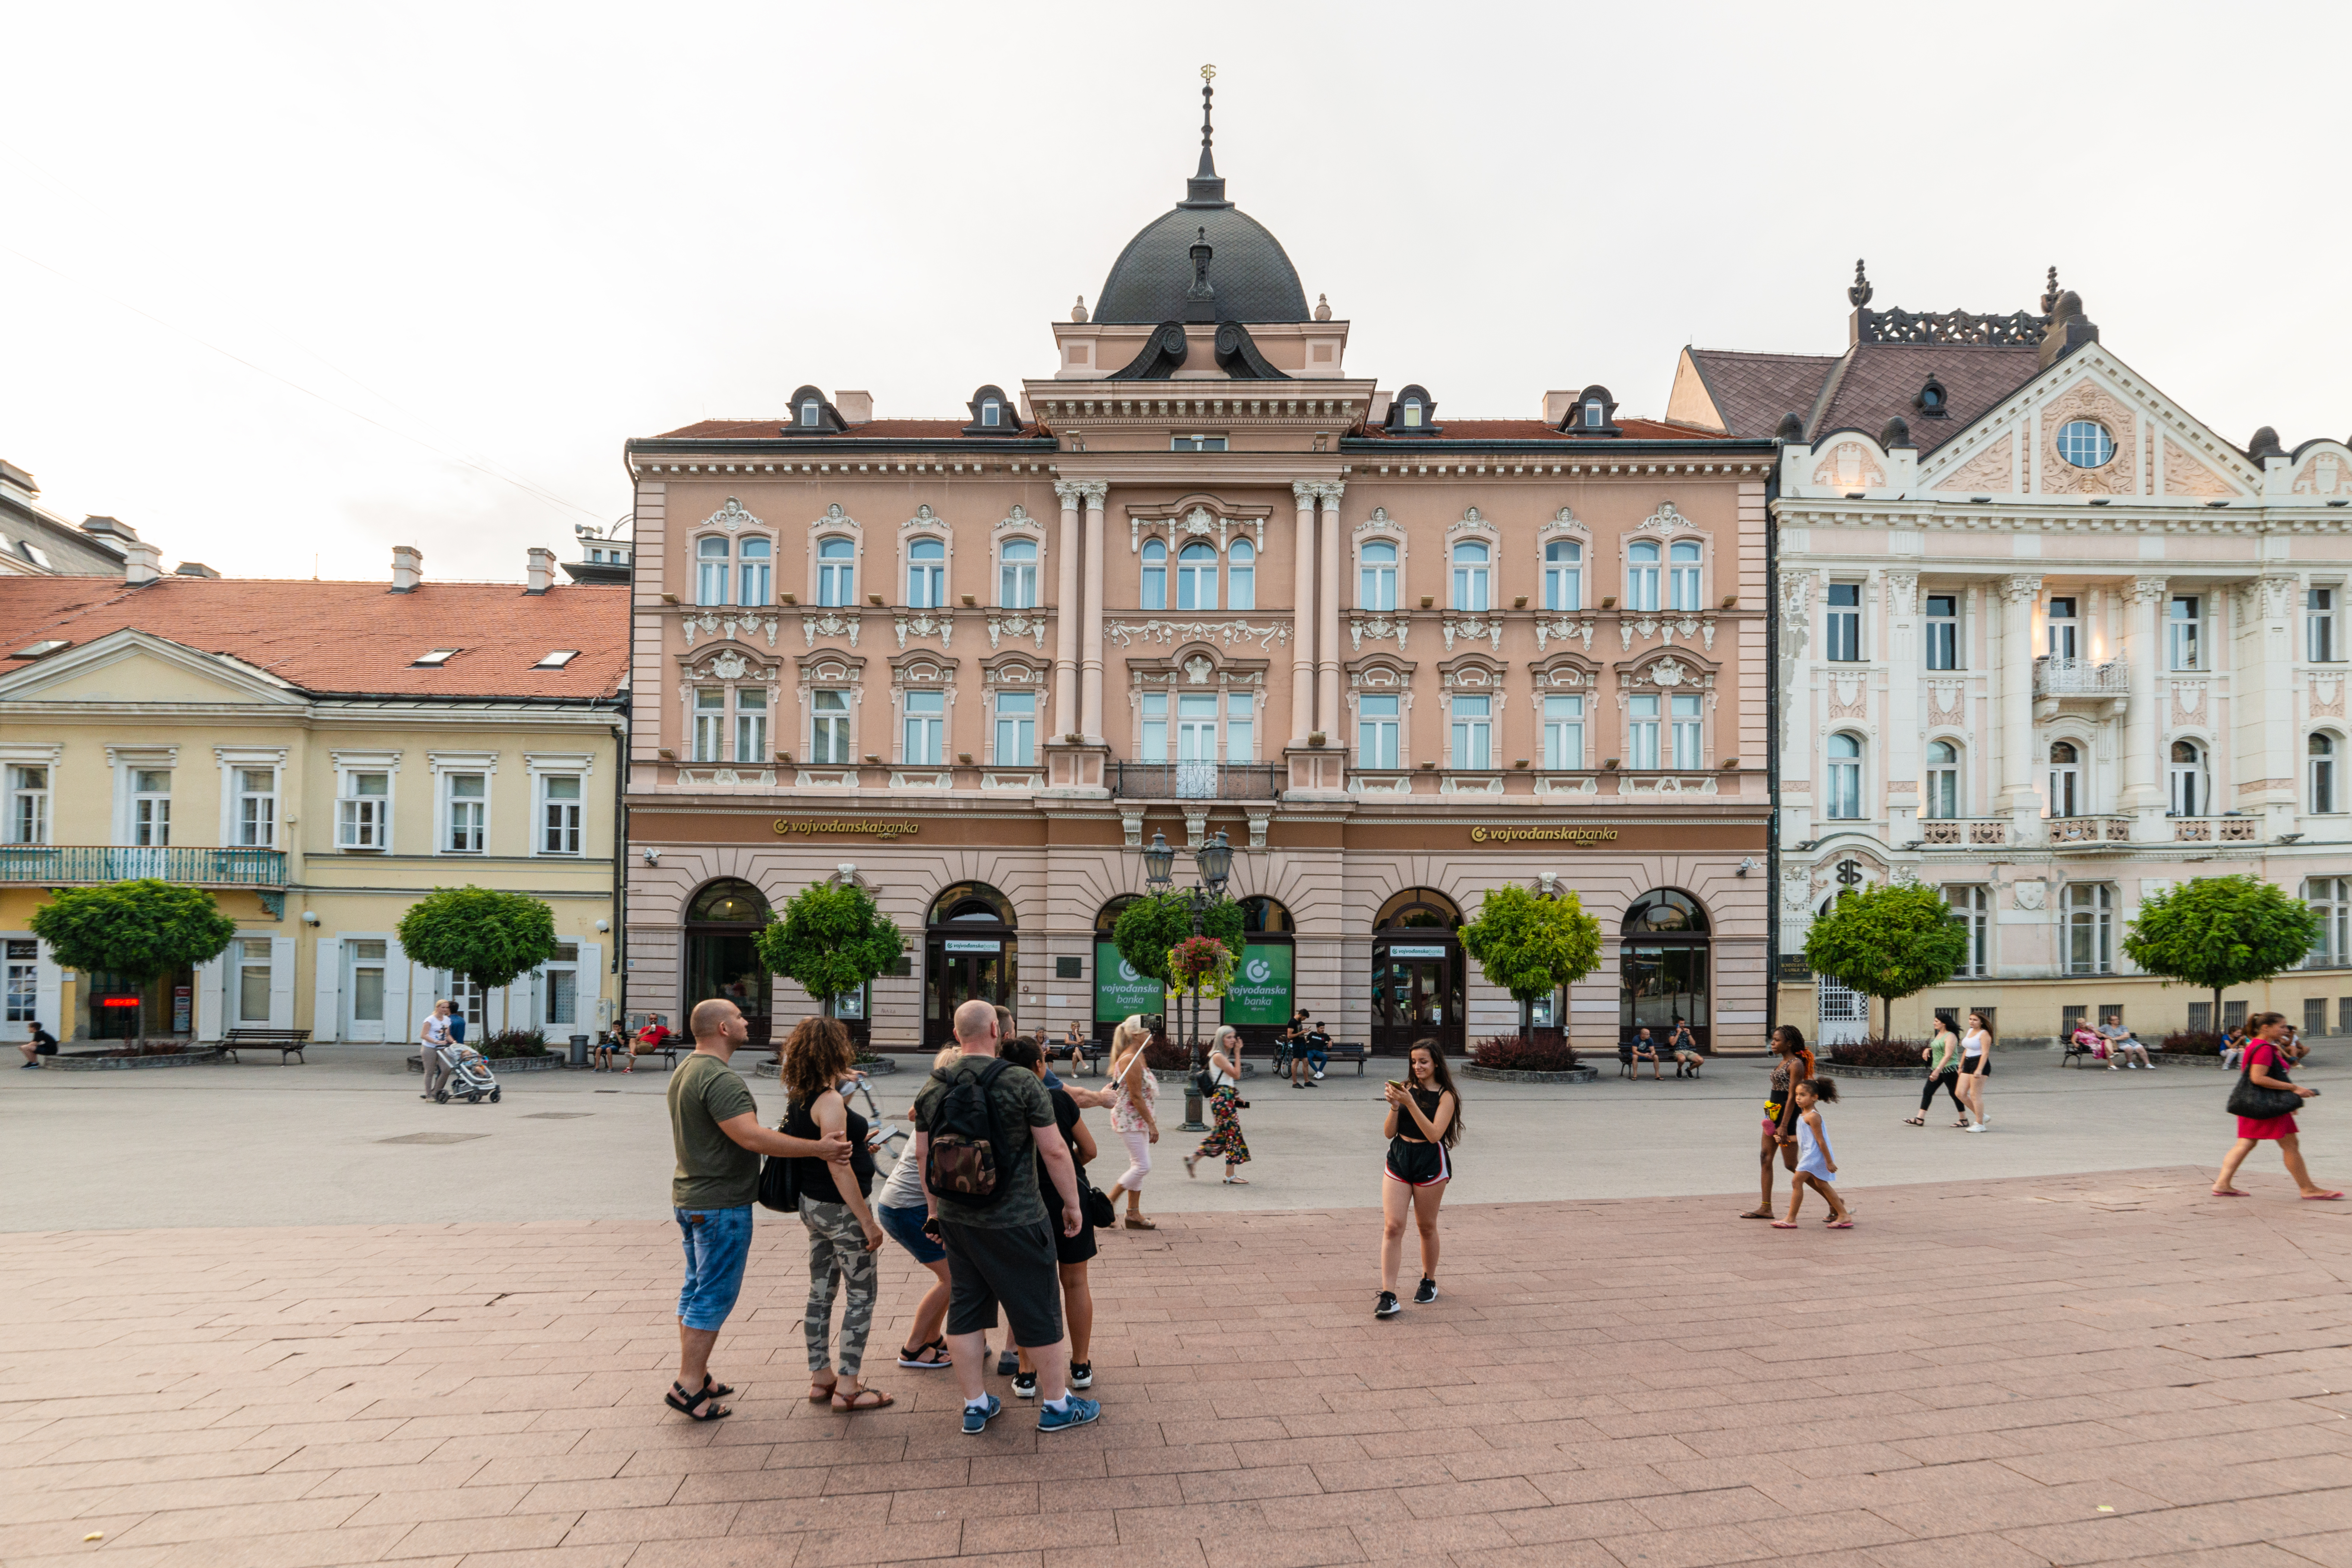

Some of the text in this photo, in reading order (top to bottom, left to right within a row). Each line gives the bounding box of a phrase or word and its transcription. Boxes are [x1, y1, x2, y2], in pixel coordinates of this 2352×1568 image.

[1102, 984, 1159, 994] vojvođanska
[1117, 995, 1144, 1004] banka
[1244, 996, 1272, 1005] banka
